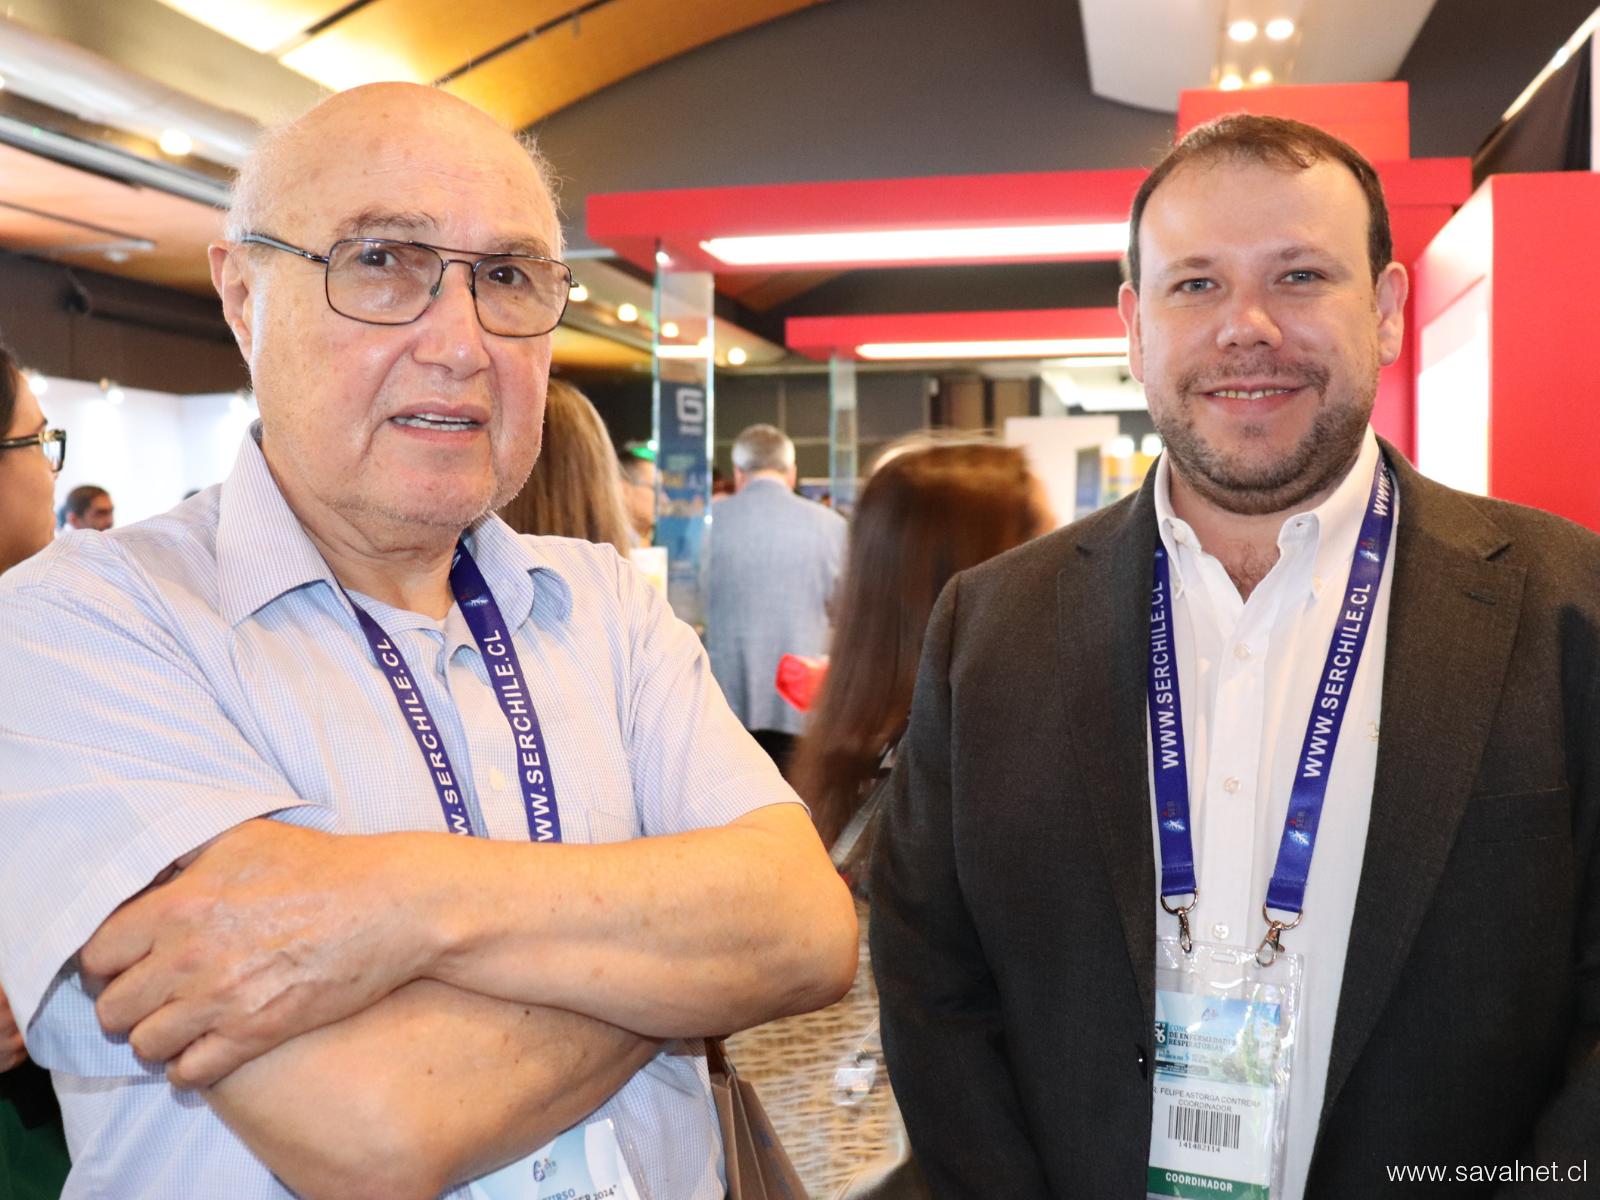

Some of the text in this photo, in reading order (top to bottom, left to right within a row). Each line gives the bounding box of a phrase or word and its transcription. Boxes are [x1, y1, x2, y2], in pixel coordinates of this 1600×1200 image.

[1151, 580, 1179, 769] WWW.SERCHILE.CL
[1303, 583, 1371, 778] WWW.SERCHILE.CL
[1165, 1172, 1233, 1192] COORDINADOR
